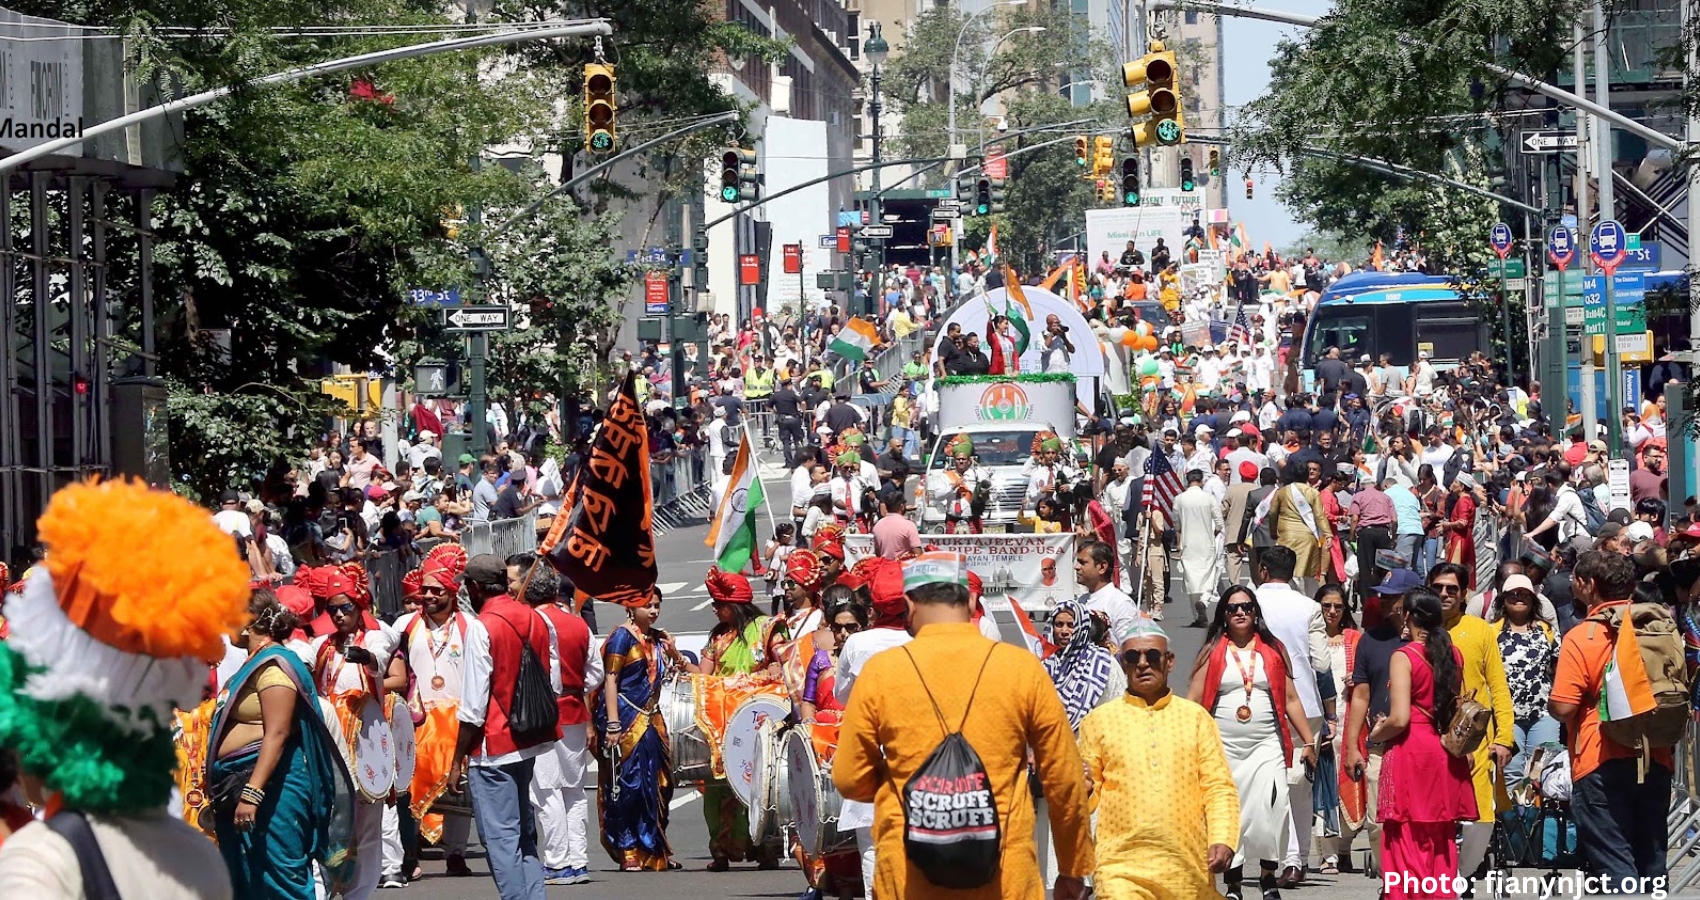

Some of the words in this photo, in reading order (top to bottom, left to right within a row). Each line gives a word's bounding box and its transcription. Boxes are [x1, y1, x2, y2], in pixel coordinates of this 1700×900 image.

[1532, 138, 1548, 146] ONE
[1557, 137, 1575, 146] WAY
[1171, 195, 1201, 204] FUTURE
[1637, 248, 1651, 261] St
[1584, 278, 1597, 289] M4
[1585, 293, 1601, 305] Q32
[455, 315, 472, 323] ONE
[480, 314, 499, 322] WAY
[1586, 307, 1606, 319] BxM4C
[1586, 321, 1606, 334] BxM11
[928, 538, 1045, 547] MUKTAJEEVAN
[949, 546, 982, 555] PIPE
[989, 546, 1066, 555] BAND-USA
[909, 790, 990, 811] SCRUFF
[909, 807, 994, 829] SCRUFF
